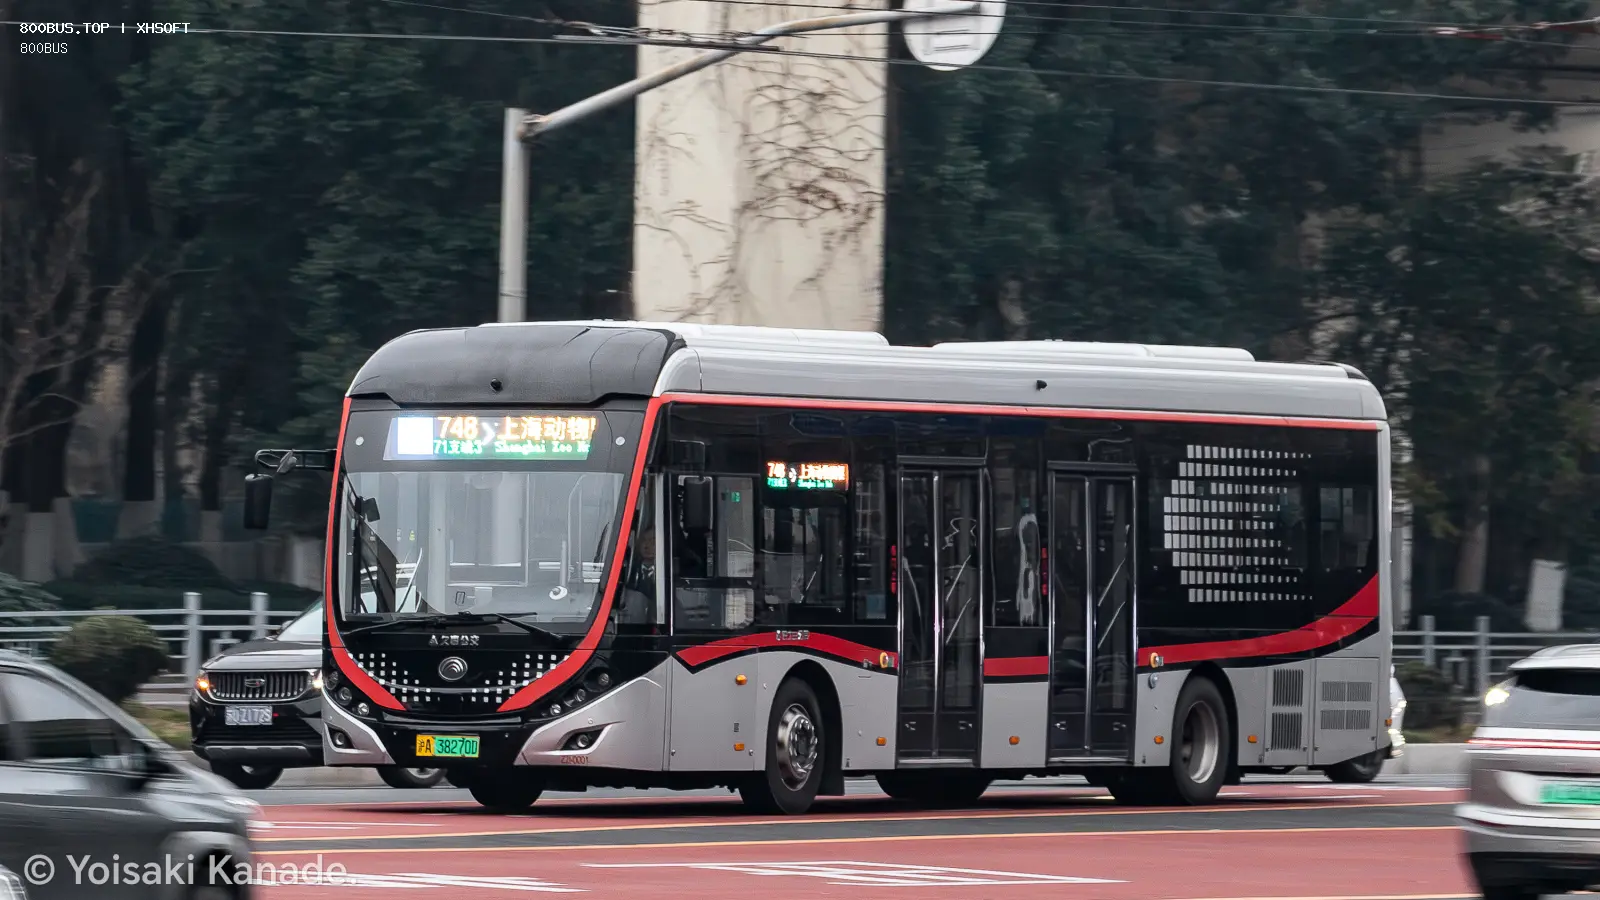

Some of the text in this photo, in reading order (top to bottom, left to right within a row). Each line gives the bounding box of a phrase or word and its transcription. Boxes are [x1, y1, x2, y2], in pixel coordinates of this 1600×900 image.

[437, 416, 596, 441] 748 上海动物
[437, 739, 478, 755] 38270D
